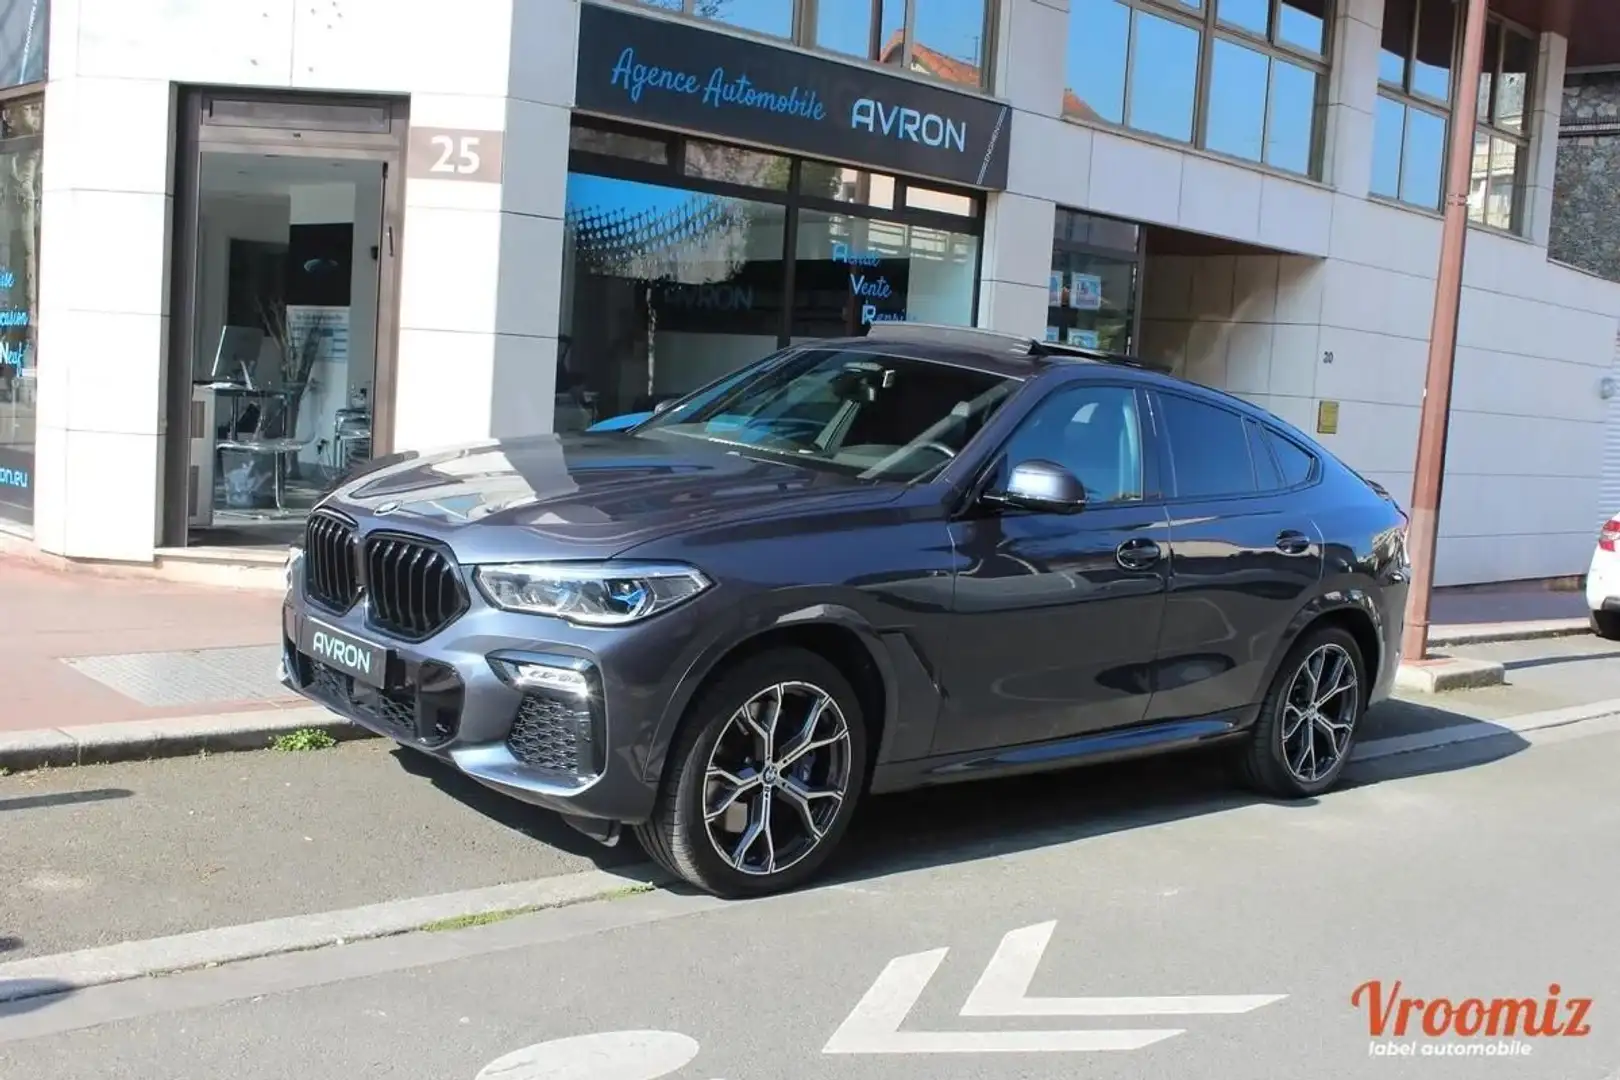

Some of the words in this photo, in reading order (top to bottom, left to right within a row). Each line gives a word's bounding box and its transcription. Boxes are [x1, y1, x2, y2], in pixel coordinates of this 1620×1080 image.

[610, 46, 701, 101] Agence
[703, 67, 827, 121] Automobile
[851, 98, 966, 152] AVRON
[429, 134, 480, 174] 25
[850, 273, 892, 298] Vente
[313, 631, 371, 674] AVRON
